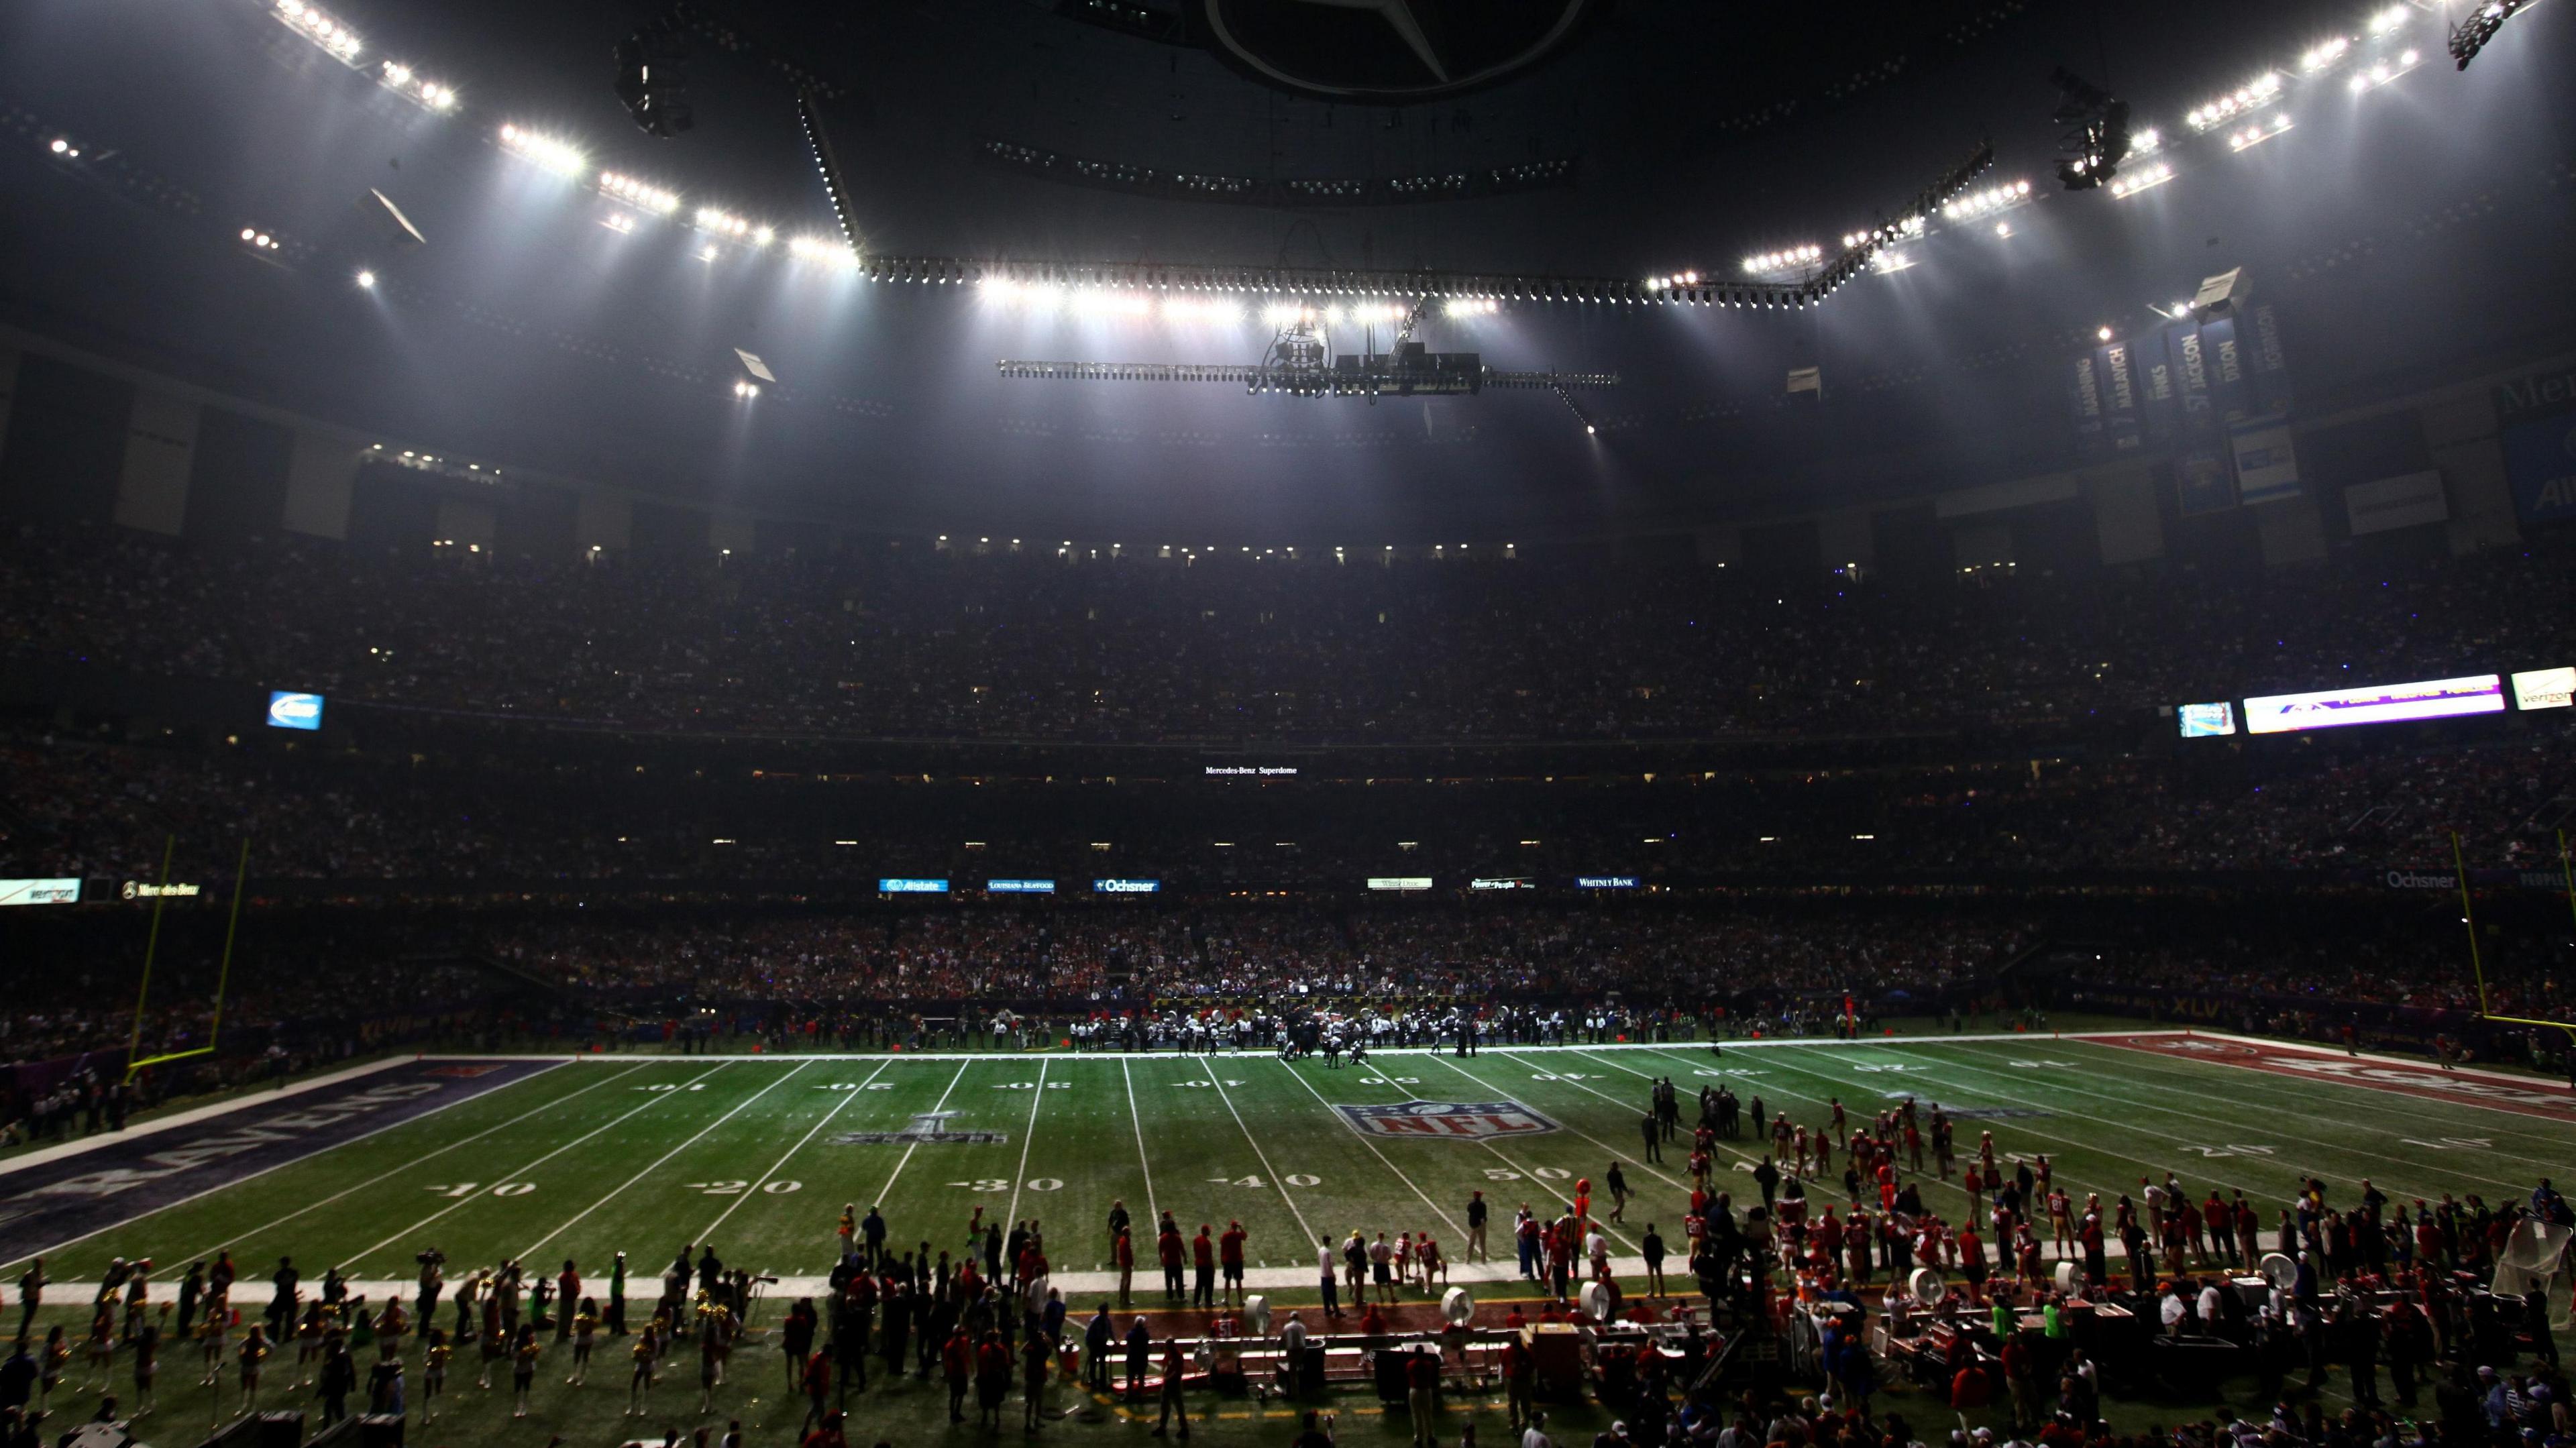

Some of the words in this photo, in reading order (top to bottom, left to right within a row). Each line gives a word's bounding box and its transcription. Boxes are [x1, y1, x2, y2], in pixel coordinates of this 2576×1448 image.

[2182, 334, 2206, 389] JACKSON
[2218, 340, 2241, 383] DIXON
[2109, 347, 2133, 408] MARAVICH
[2151, 364, 2171, 400] FINKS
[1205, 767, 1256, 775] Mercedes-Benz
[1259, 767, 1297, 776] Superdome
[903, 881, 938, 891] Allstate
[1105, 879, 1155, 892] Ochsner
[1579, 878, 1612, 887] WHITNEY
[1613, 877, 1633, 887] BANK
[2387, 871, 2455, 889] Ochsner
[1373, 1115, 1538, 1135] NFL
[3, 1082, 444, 1201] RAVENS
[1232, 1174, 1322, 1188] 40
[1483, 1167, 1572, 1181] 50
[437, 1182, 537, 1196] 10
[702, 1180, 802, 1194] 20
[971, 1178, 1065, 1192] 30
